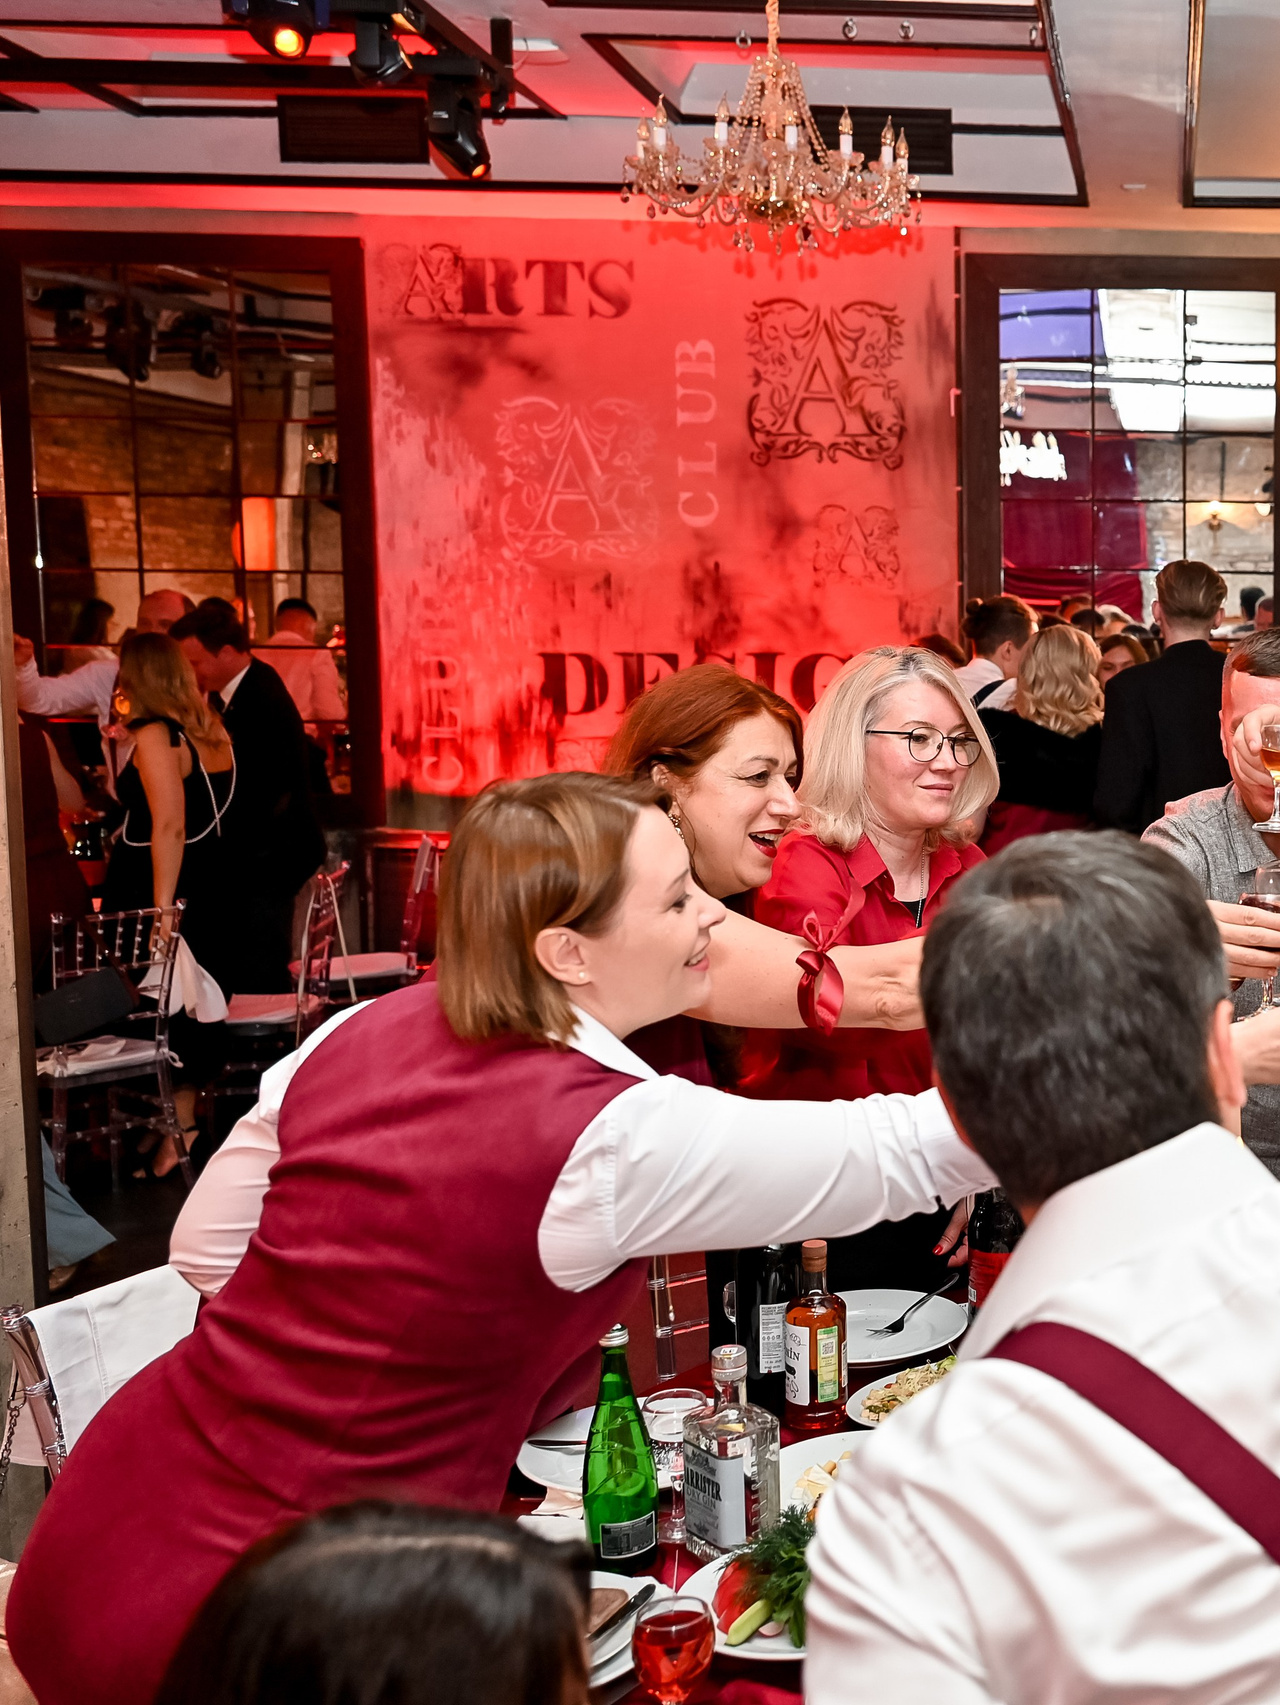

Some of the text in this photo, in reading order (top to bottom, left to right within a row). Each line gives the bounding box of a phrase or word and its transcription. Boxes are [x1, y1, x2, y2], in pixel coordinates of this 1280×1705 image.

[398, 245, 637, 320] ARTS
[675, 339, 720, 528] CLUB
[684, 1466, 722, 1502] ARRISTER
[702, 1494, 716, 1509] GIN
